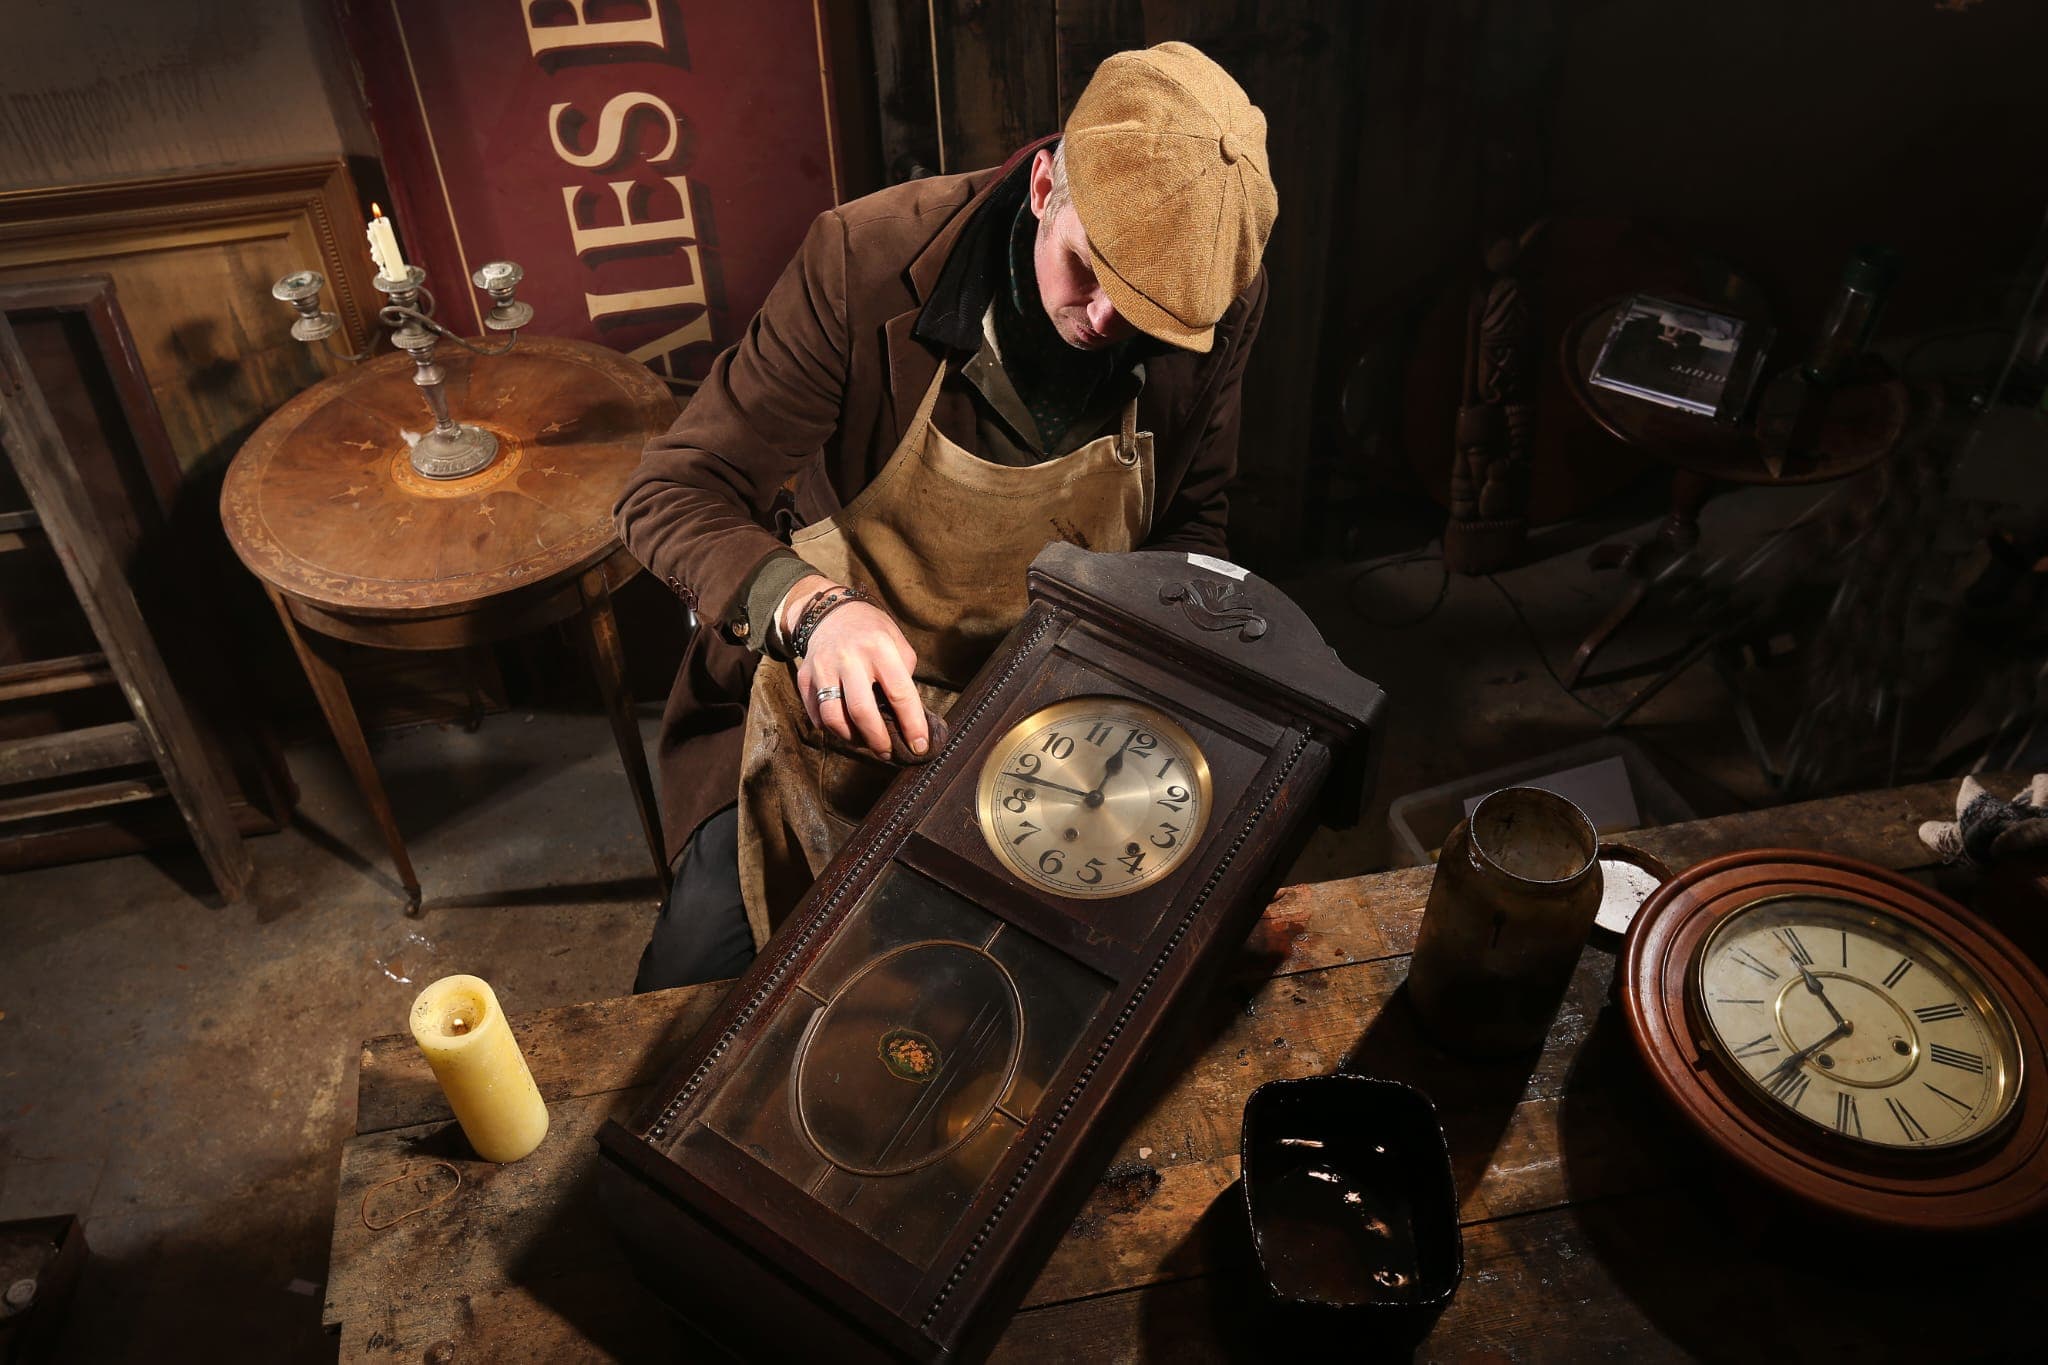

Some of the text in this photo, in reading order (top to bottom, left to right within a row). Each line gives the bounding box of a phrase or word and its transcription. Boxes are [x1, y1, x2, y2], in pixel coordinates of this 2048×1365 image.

[1041, 732, 1075, 760] 10
[1084, 722, 1113, 747] 11
[1123, 728, 1158, 759] 12
[1015, 753, 1041, 778] 9
[1156, 757, 1176, 780] 1
[1002, 788, 1034, 814] 8
[1156, 785, 1191, 813] 2
[1012, 820, 1042, 846] 7
[1150, 822, 1181, 849] 3
[1038, 849, 1066, 876] 6
[1076, 857, 1106, 885] 5
[1117, 851, 1147, 875] 4
[1882, 957, 1914, 989] II
[1913, 1003, 1965, 1024] III
[1929, 1043, 1985, 1075] IIII
